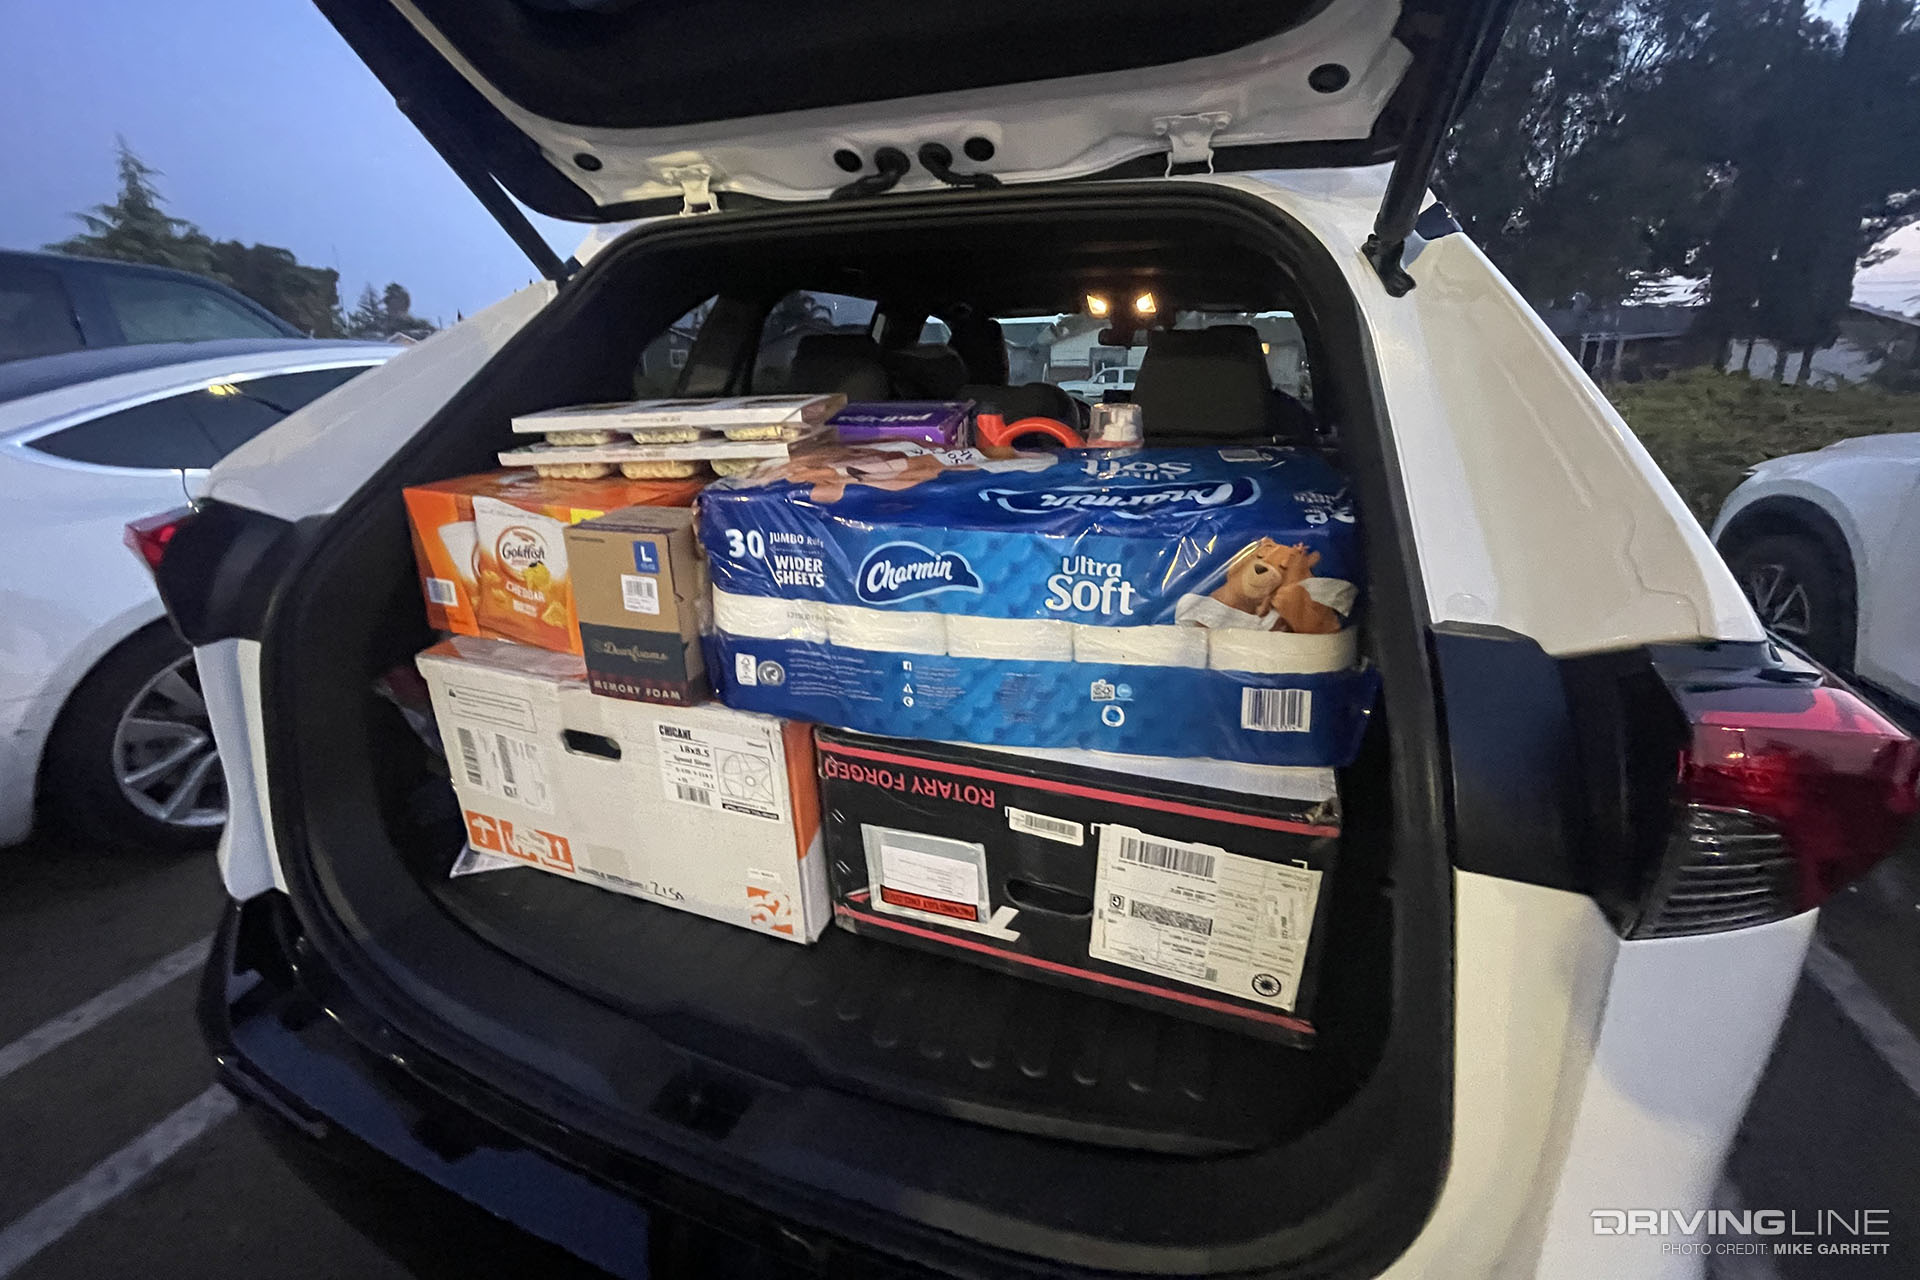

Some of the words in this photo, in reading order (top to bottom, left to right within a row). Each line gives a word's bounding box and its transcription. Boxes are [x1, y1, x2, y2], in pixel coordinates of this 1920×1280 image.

[725, 528, 765, 559] 30
[769, 531, 804, 545] JUMBO
[502, 541, 546, 560] Goldfish
[640, 545, 653, 562] L
[774, 554, 823, 573] WIDER
[866, 555, 953, 593] Charmin
[1062, 555, 1122, 578] Ultra
[776, 570, 825, 588] SHEETS
[1045, 573, 1135, 616] Soft
[593, 680, 640, 695] MEMORY
[646, 687, 681, 700] FOAM
[824, 757, 906, 792] FORGED
[911, 775, 996, 809] ROTARY
